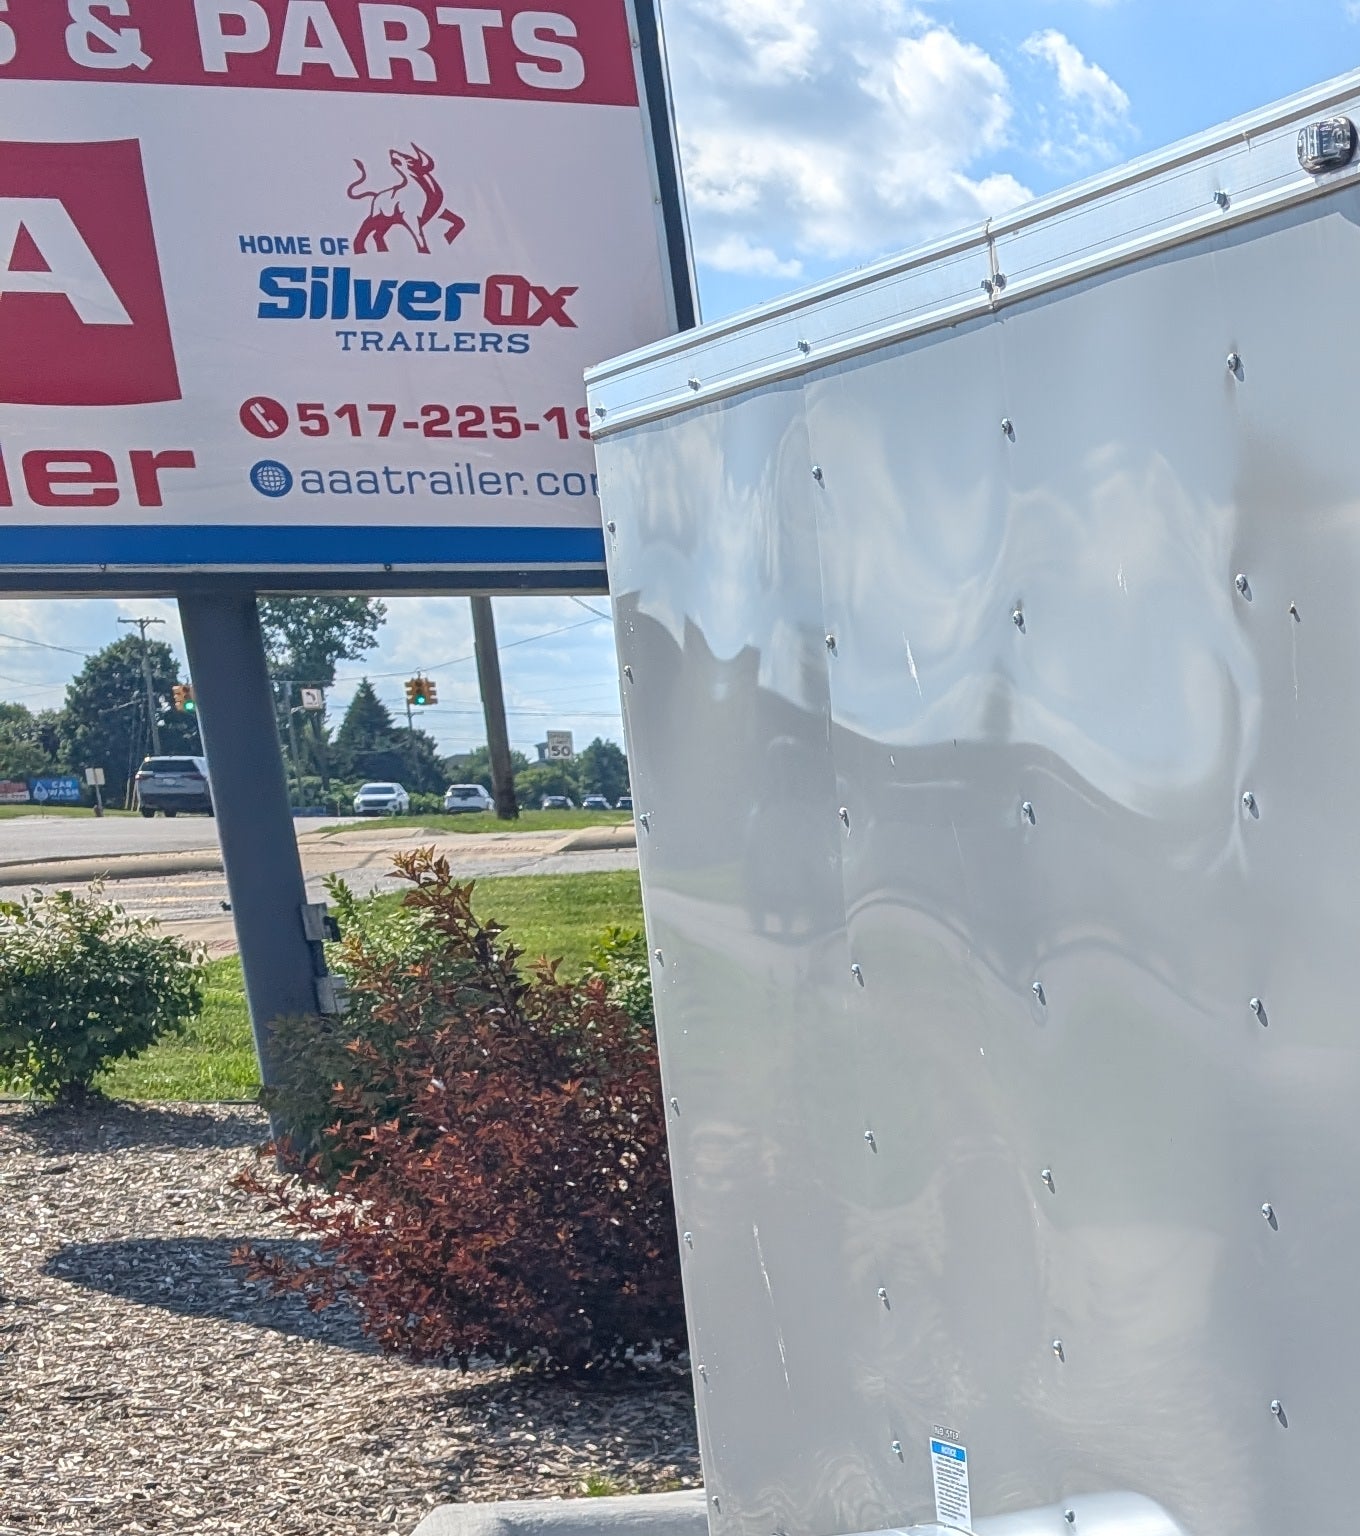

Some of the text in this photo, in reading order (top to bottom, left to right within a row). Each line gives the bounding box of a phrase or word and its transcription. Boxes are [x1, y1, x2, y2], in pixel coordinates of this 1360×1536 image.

[65, 0, 153, 71] &
[192, 0, 587, 90] PARTS
[239, 235, 349, 256] HOME OF
[257, 266, 579, 328] SilverOx
[335, 330, 531, 354] TRAILERS
[0, 448, 197, 507] er
[300, 462, 599, 497] aaatrailer.co
[551, 745, 571, 757] 50
[47, 788, 79, 796] WASH
[51, 780, 73, 788] CAR
